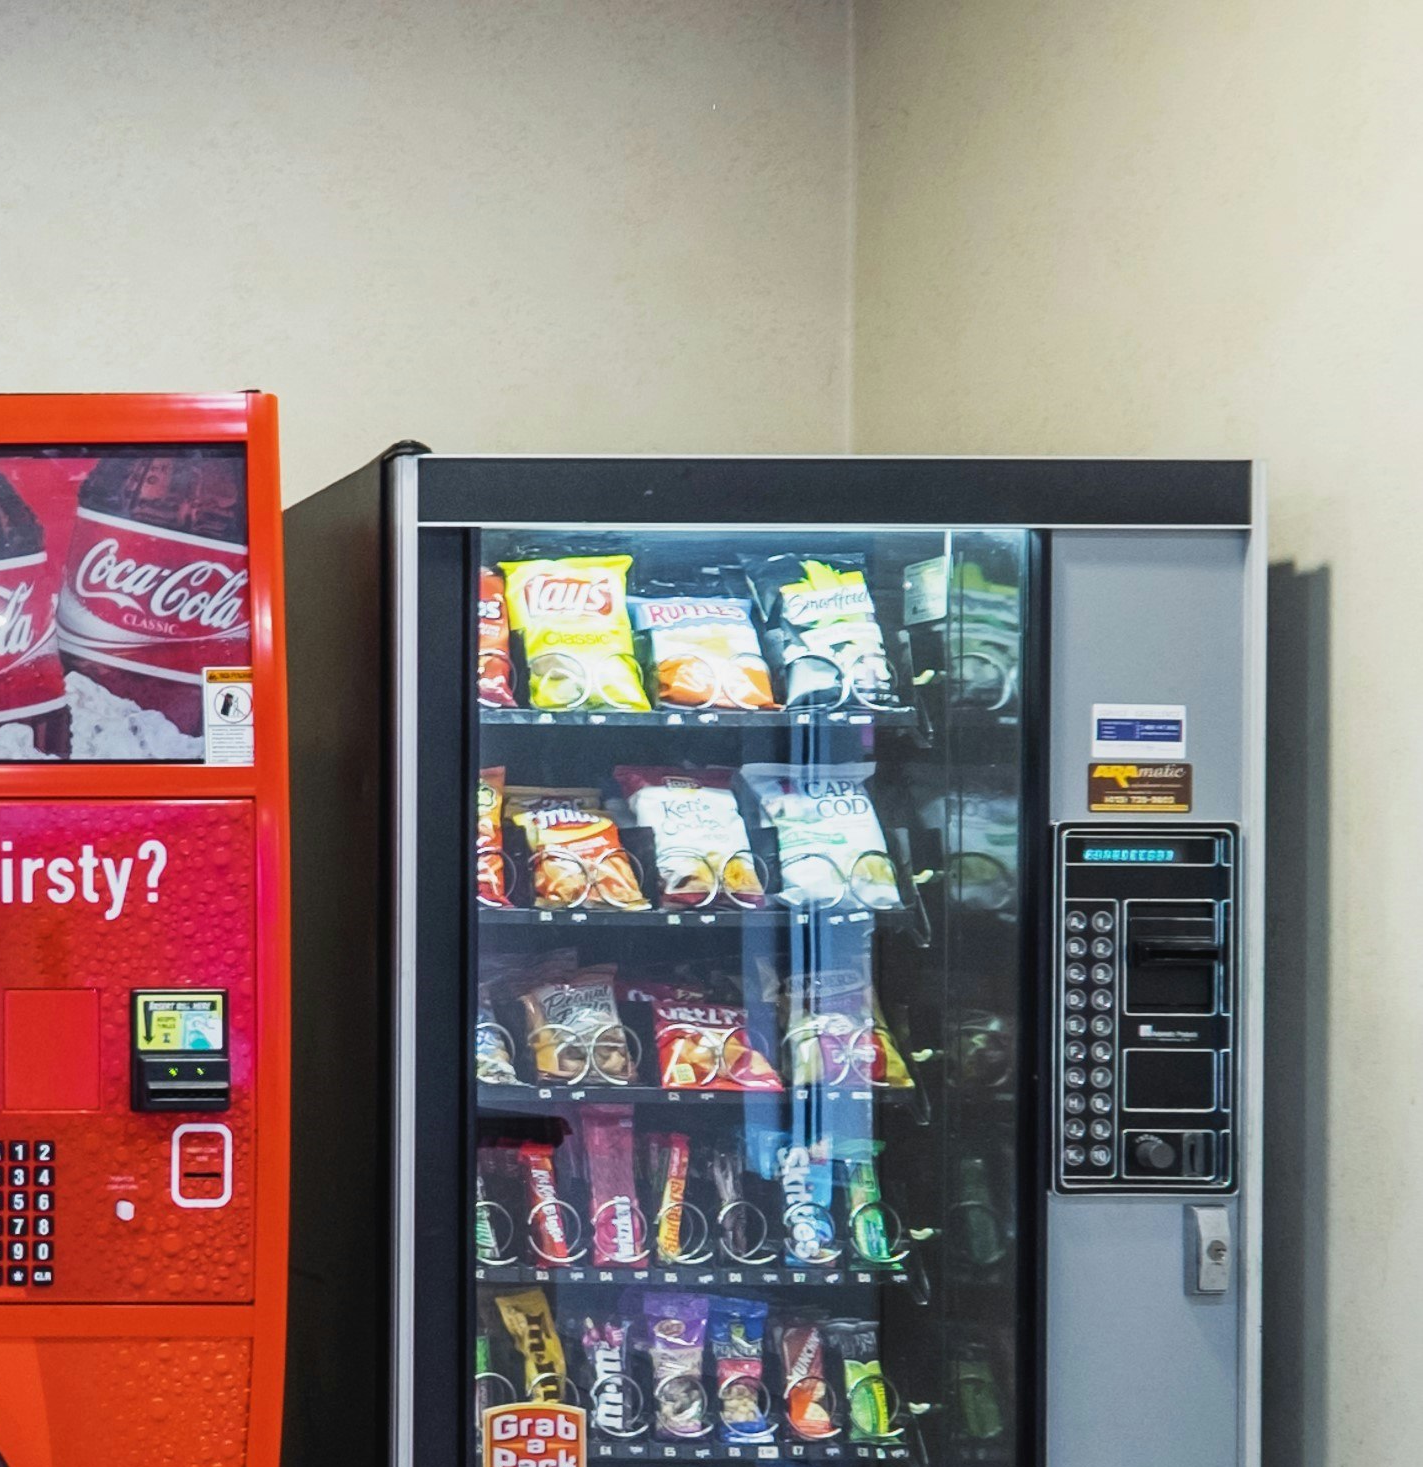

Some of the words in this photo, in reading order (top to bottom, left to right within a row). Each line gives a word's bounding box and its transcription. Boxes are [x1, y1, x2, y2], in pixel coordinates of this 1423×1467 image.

[76, 537, 249, 630] Coca-Cola
[529, 573, 613, 615] Lay's
[648, 602, 747, 622] RUFFLES
[122, 612, 180, 636] CLASSIC
[542, 629, 611, 647] Classic
[1092, 764, 1186, 788] ARAmatic
[816, 799, 869, 818] COD
[14, 1144, 24, 1161] 1
[39, 1144, 50, 1161] 2
[13, 1169, 25, 1186] 3
[38, 1169, 50, 1186] 4
[13, 1193, 24, 1211] 5
[38, 1193, 49, 1211] 6
[13, 1218, 24, 1235] 7
[38, 1218, 49, 1235] 8
[13, 1243, 23, 1260] 9
[38, 1243, 49, 1260] 0
[33, 1271, 51, 1281] CLR
[493, 1413, 578, 1441] Grab
[526, 1439, 546, 1454] a
